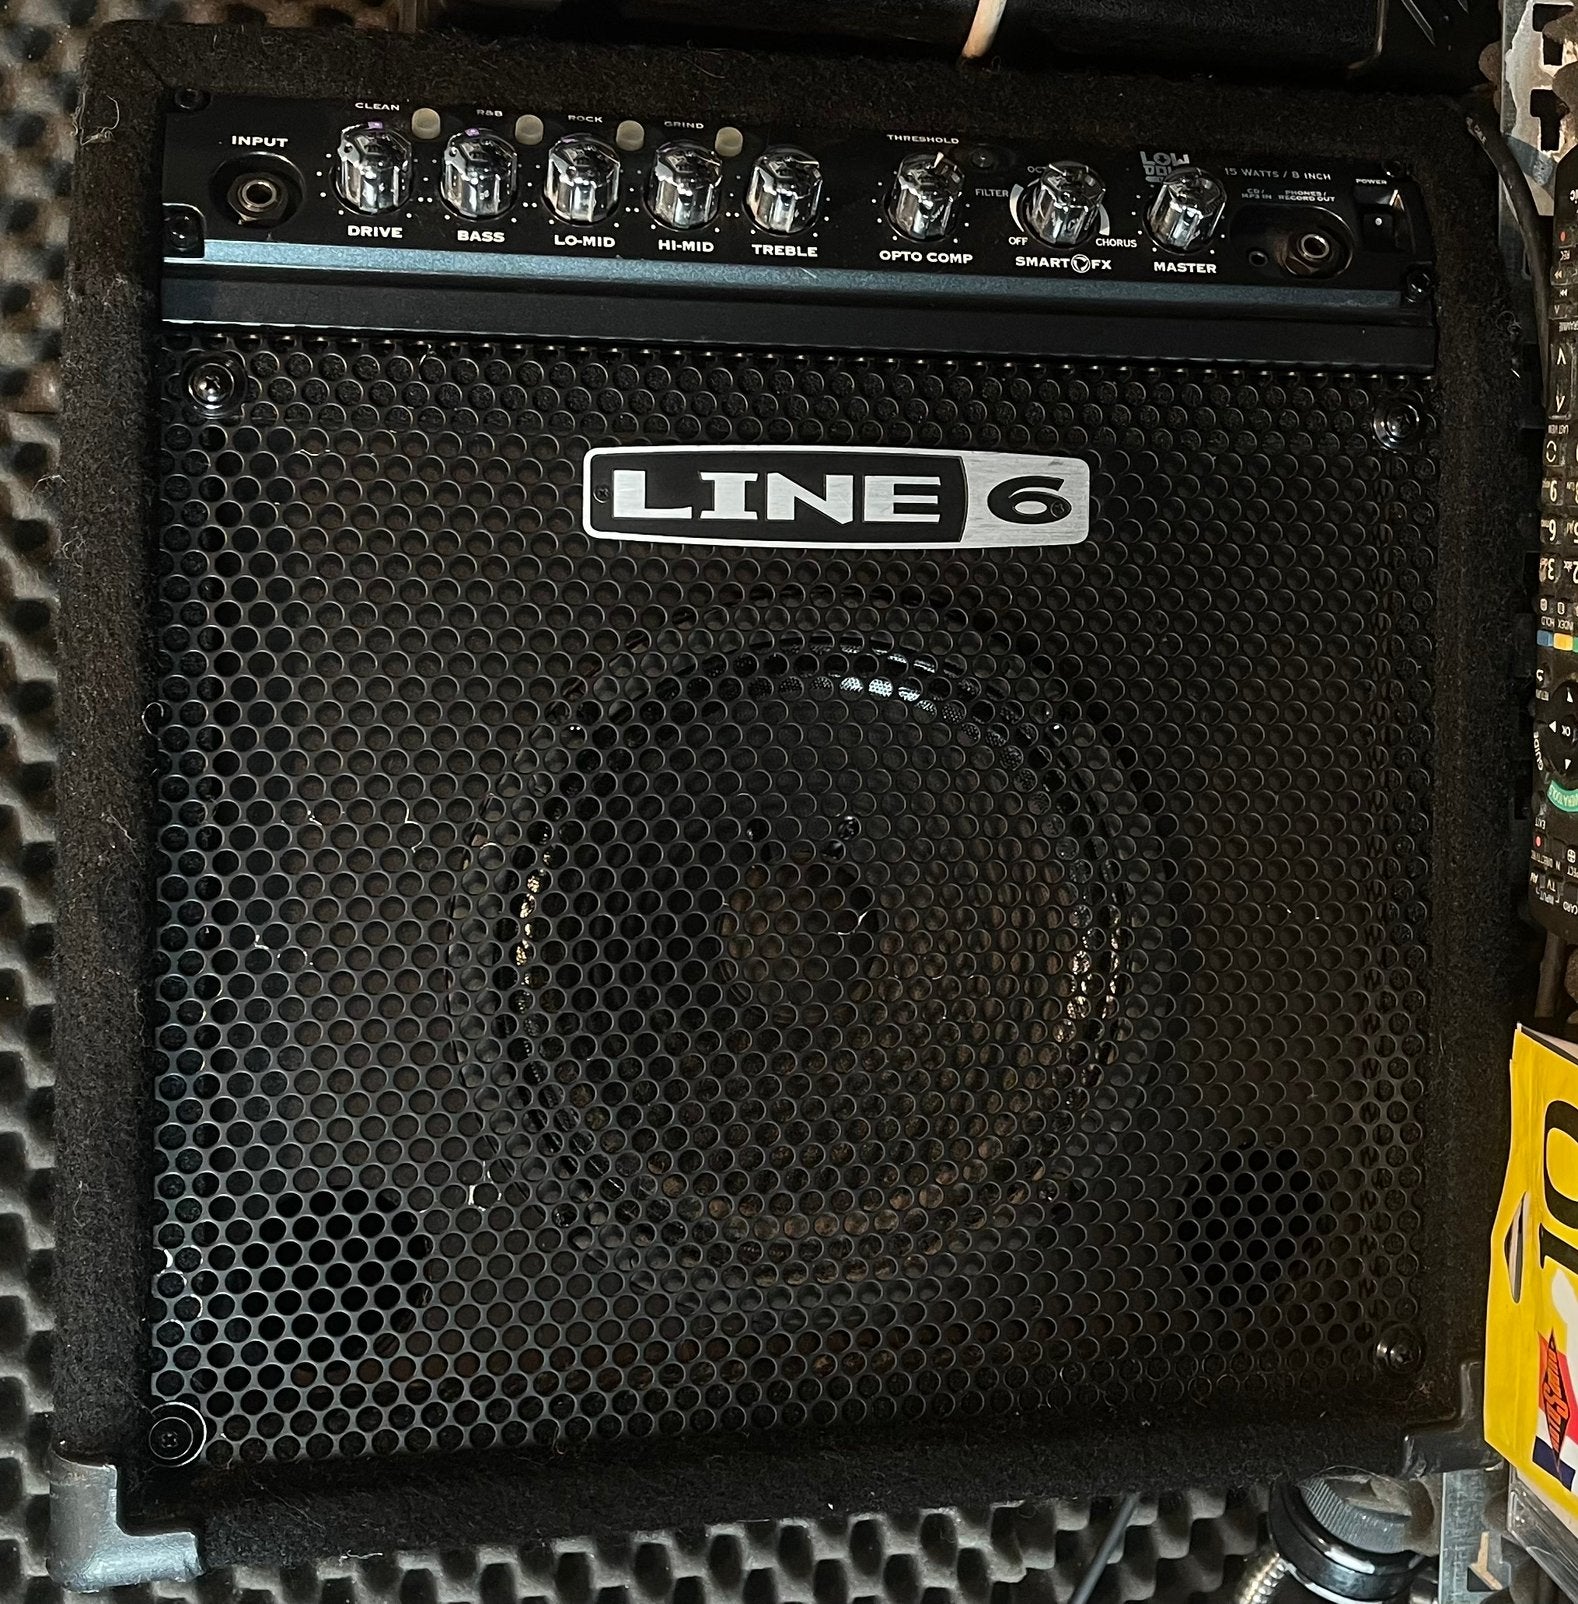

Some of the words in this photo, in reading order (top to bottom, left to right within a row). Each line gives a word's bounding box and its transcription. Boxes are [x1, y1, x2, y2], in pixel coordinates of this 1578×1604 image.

[354, 101, 400, 111] CLEAN
[476, 109, 503, 117] R&B
[567, 114, 603, 123] ROCK
[664, 120, 705, 130] GRIND
[231, 135, 289, 148] INPUT
[886, 133, 960, 145] THRESHOLD
[1139, 150, 1190, 167] LOW
[1224, 167, 1238, 176] 15
[1240, 168, 1280, 178] WATTS
[1303, 172, 1331, 181] INCH
[975, 188, 1009, 198] FILTER
[1277, 194, 1316, 202] RECORD
[347, 225, 403, 239] DRIVE
[457, 229, 506, 243] BASS
[554, 234, 616, 248] LO-MID
[658, 239, 715, 253] HI-MID
[1008, 235, 1028, 246] OFF
[1095, 237, 1138, 248] CHORUS
[751, 243, 819, 258] TREBLE
[879, 249, 923, 263] OPTO
[926, 251, 974, 264] COMP
[1015, 255, 1070, 269] SMART
[1091, 259, 1112, 270] FX
[1153, 261, 1217, 274] MASTER
[612, 469, 942, 525] LINE
[986, 474, 1073, 525] 6
[1550, 480, 1557, 502] 9
[1549, 519, 1557, 542] 6
[1548, 558, 1555, 581] 3
[1561, 725, 1571, 737] OK
[1533, 731, 1544, 771] GUIDE
[1534, 817, 1546, 830] EXIT
[1547, 879, 1556, 892] TV
[1563, 901, 1578, 915] CARD
